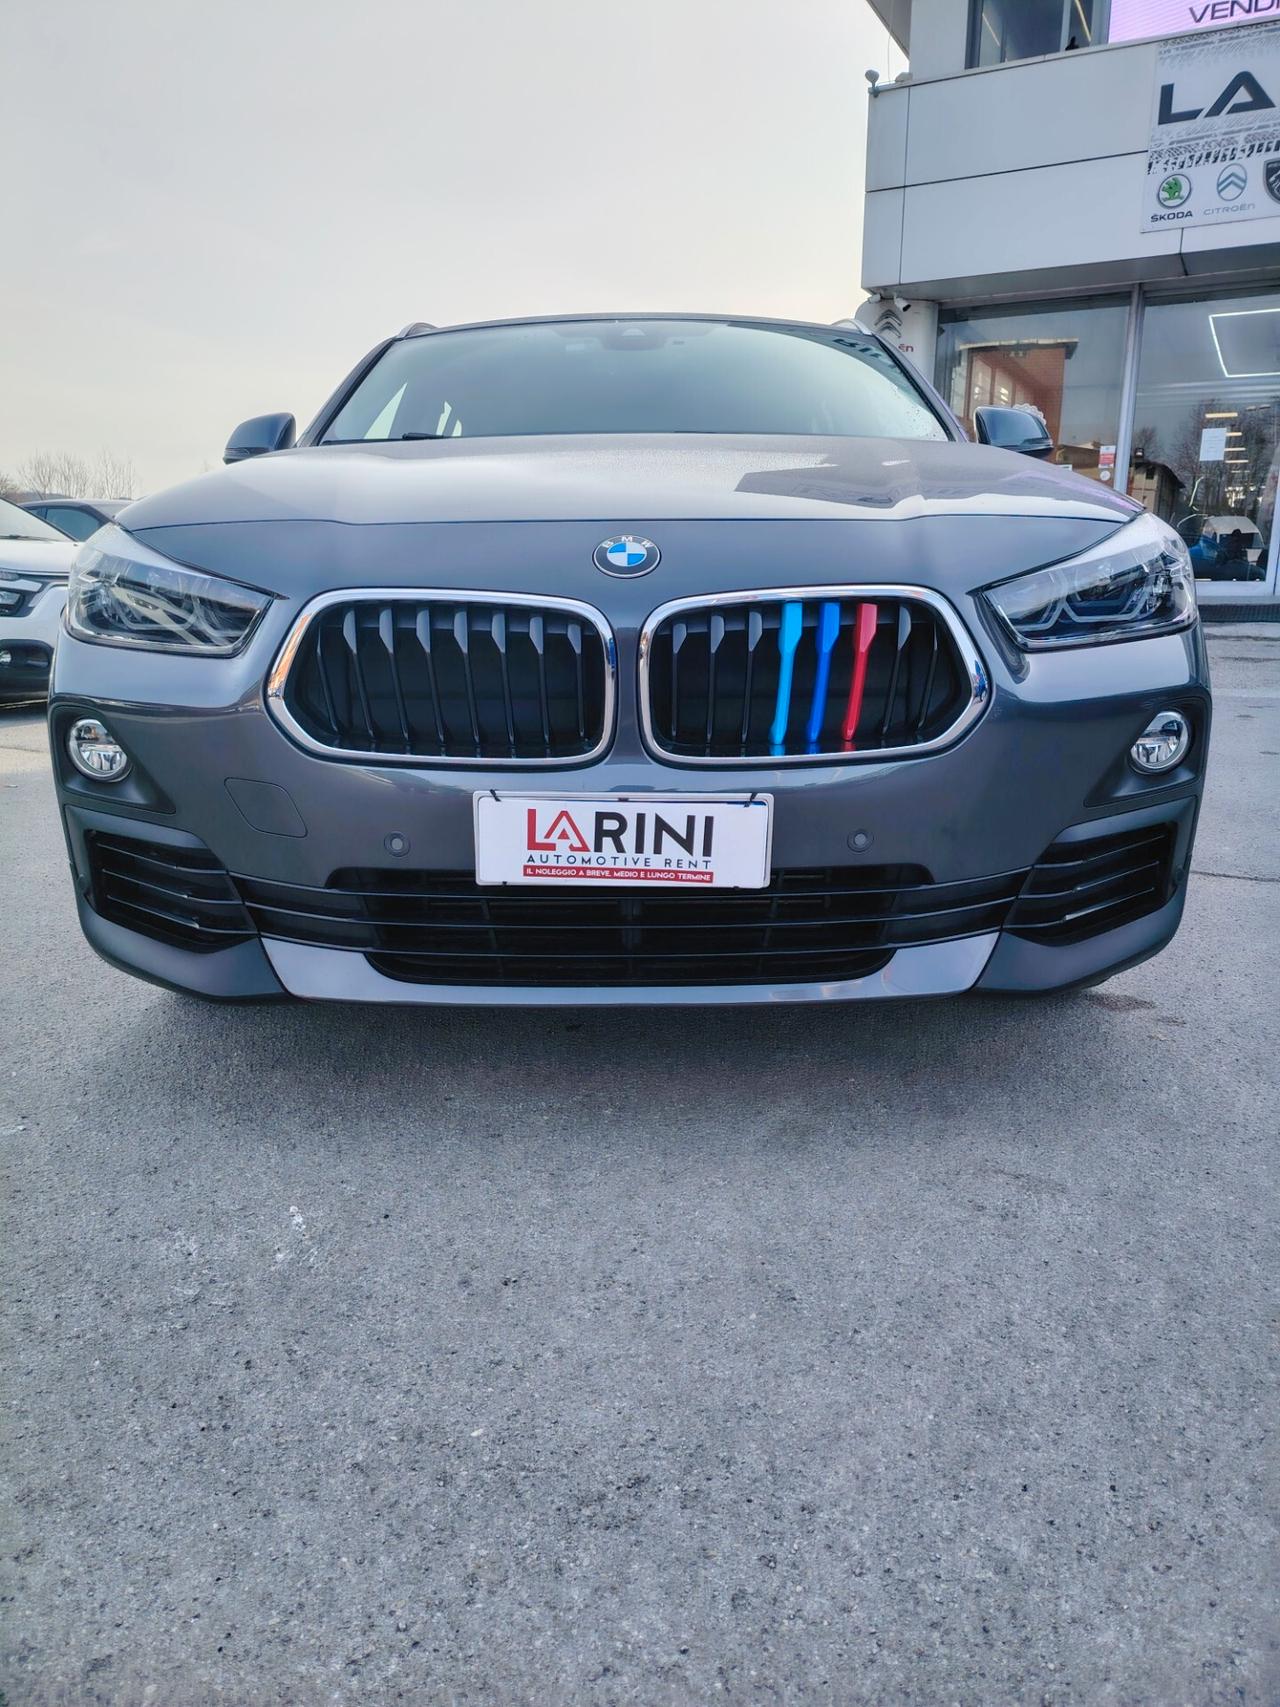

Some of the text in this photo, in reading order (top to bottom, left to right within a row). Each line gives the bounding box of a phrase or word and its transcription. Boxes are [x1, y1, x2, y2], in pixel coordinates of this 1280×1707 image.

[1158, 70, 1276, 126] LA
[1150, 210, 1194, 223] ŠKODA
[601, 535, 655, 548] BMW
[527, 808, 714, 857] LARINI
[526, 854, 711, 870] AUTOMOTIVE RENT
[535, 868, 577, 876] NOLEGGIO
[647, 872, 675, 880] LUNGO
[678, 873, 711, 881] TERMINE
